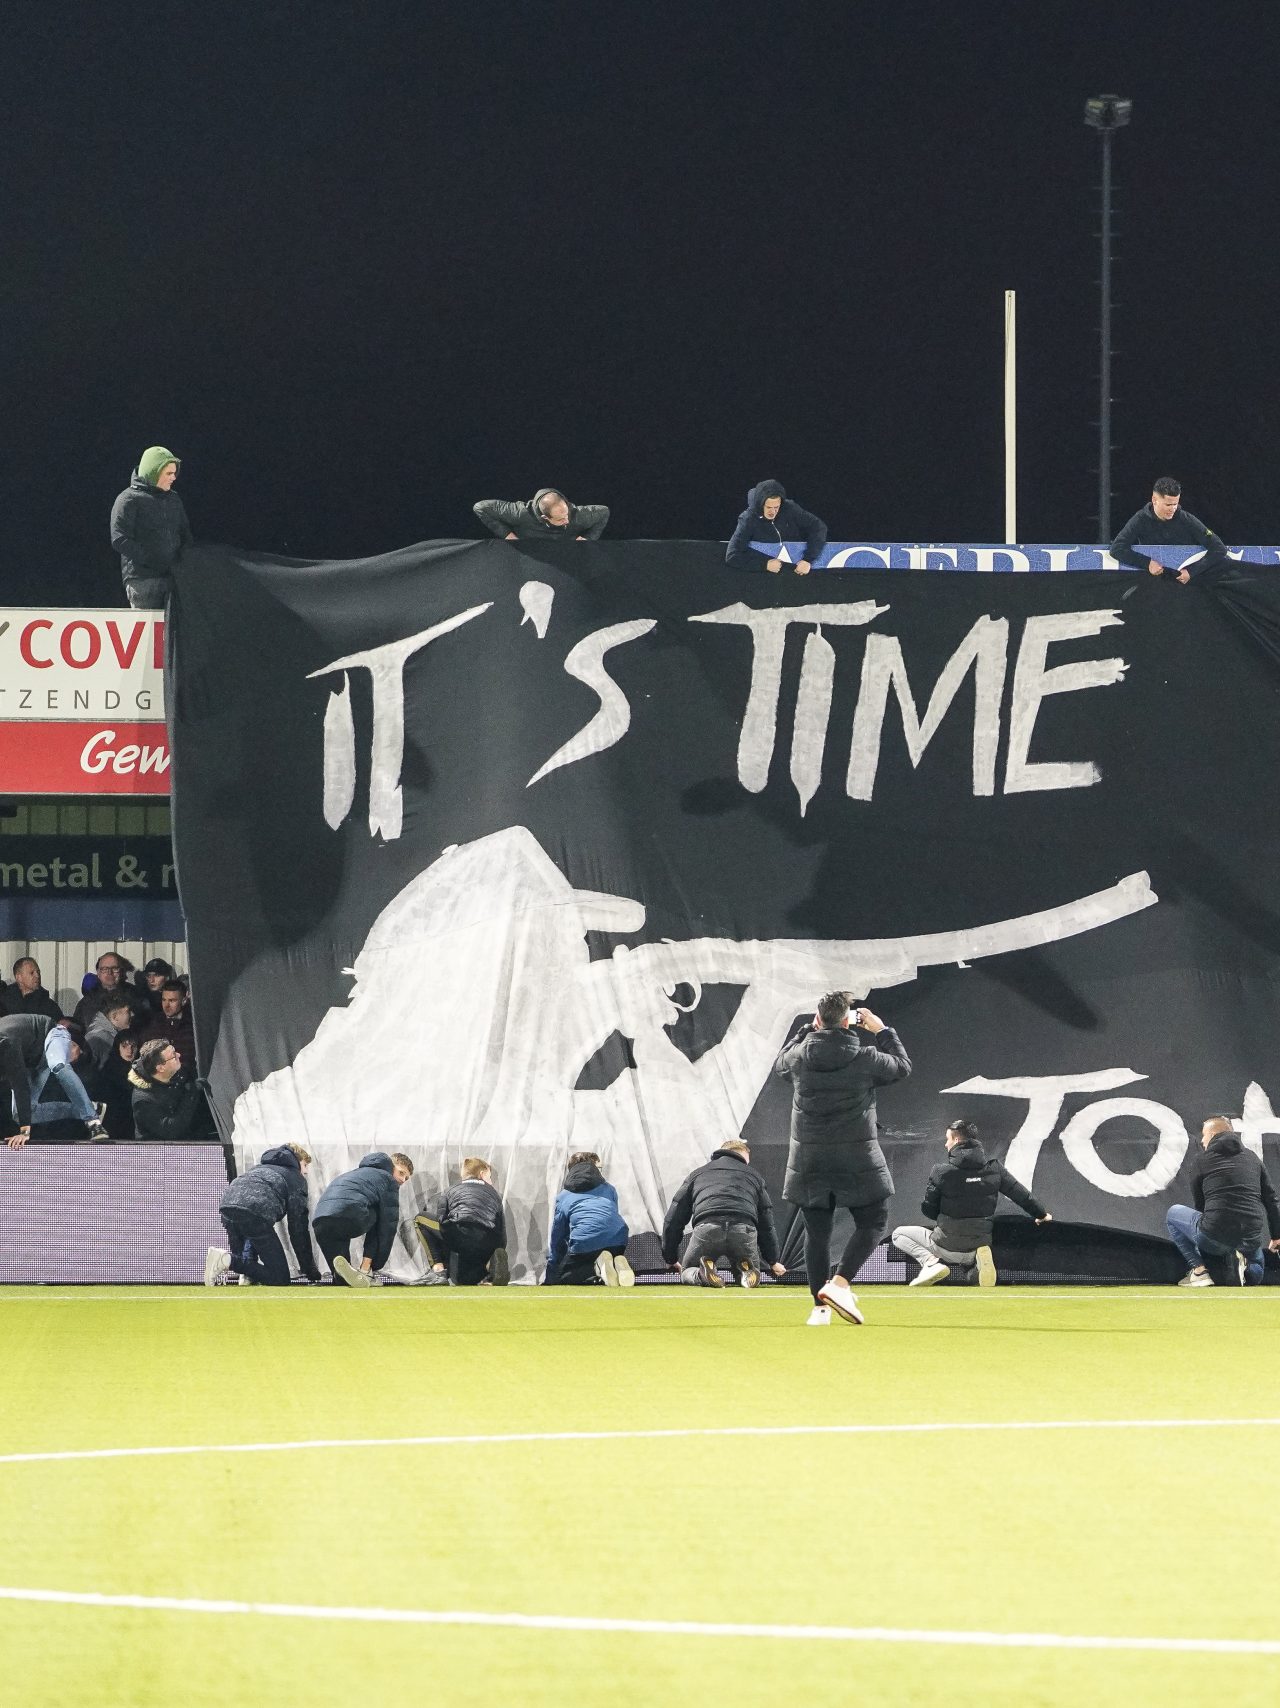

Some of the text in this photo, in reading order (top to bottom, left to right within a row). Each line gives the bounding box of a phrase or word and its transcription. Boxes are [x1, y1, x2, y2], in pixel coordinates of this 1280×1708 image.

[80, 730, 171, 774] Gew
[688, 600, 1130, 818] TIME
[115, 854, 148, 888] &
[939, 1067, 1190, 1197] TO
